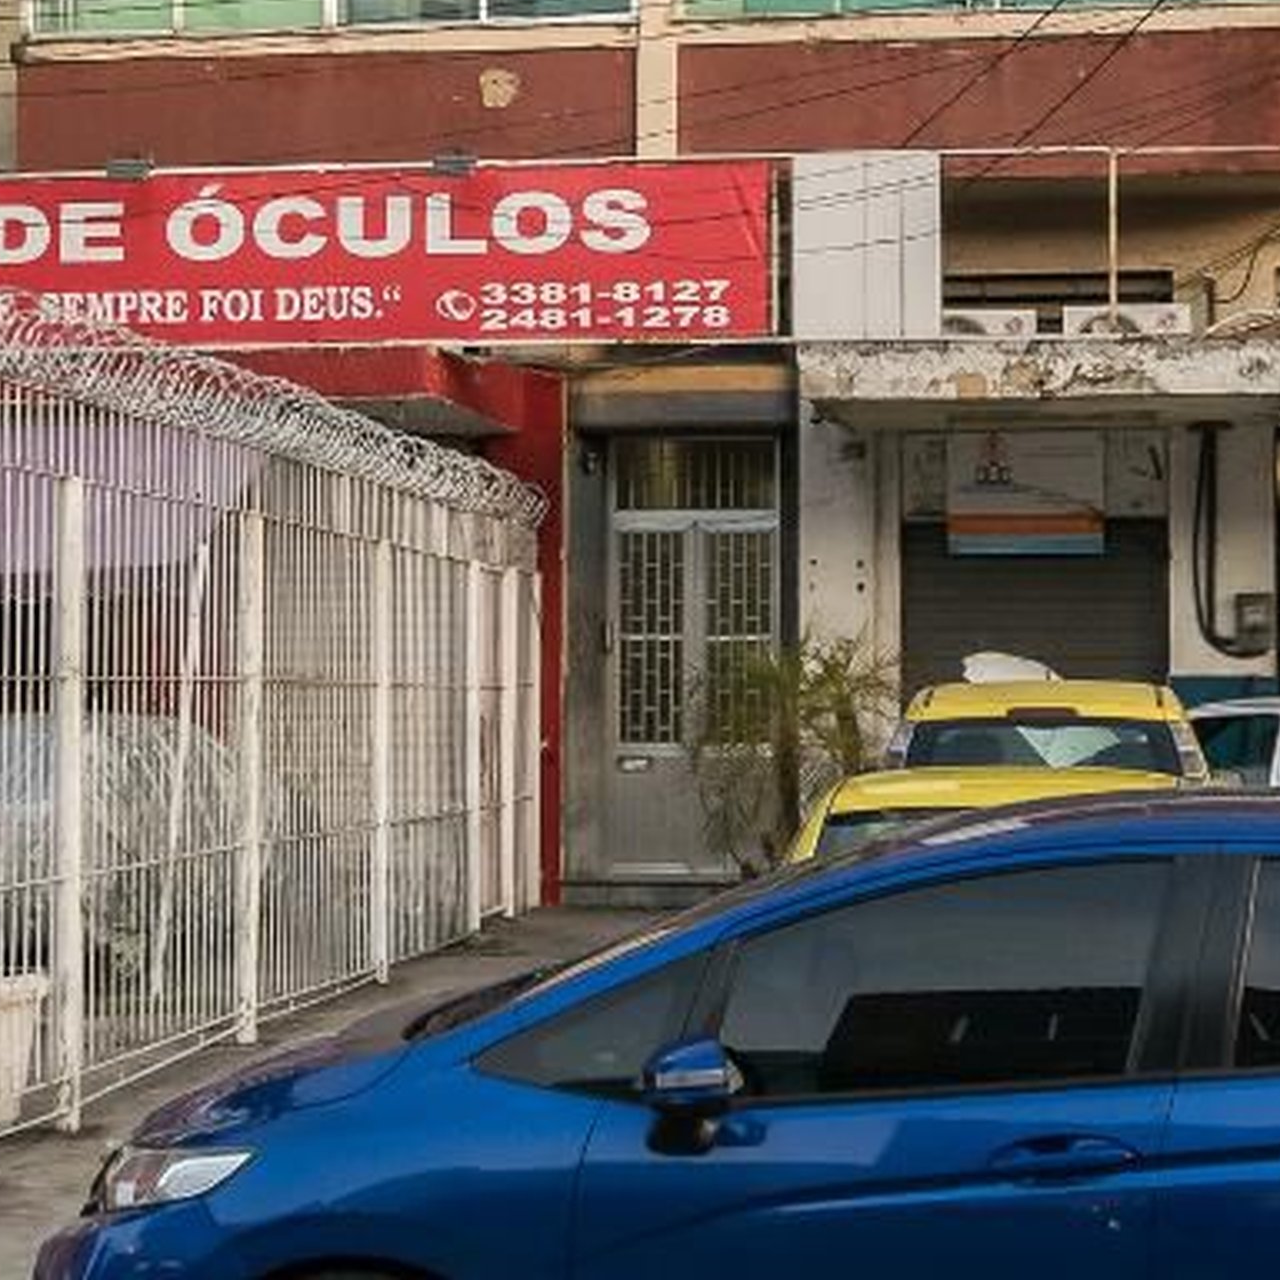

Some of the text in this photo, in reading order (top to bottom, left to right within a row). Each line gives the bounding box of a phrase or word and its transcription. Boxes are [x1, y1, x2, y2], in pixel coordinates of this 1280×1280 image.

[164, 183, 651, 261] ÓCULOS
[199, 288, 264, 323] FOI
[479, 279, 731, 306] 3381-8127
[479, 305, 731, 331] 2481-1278
